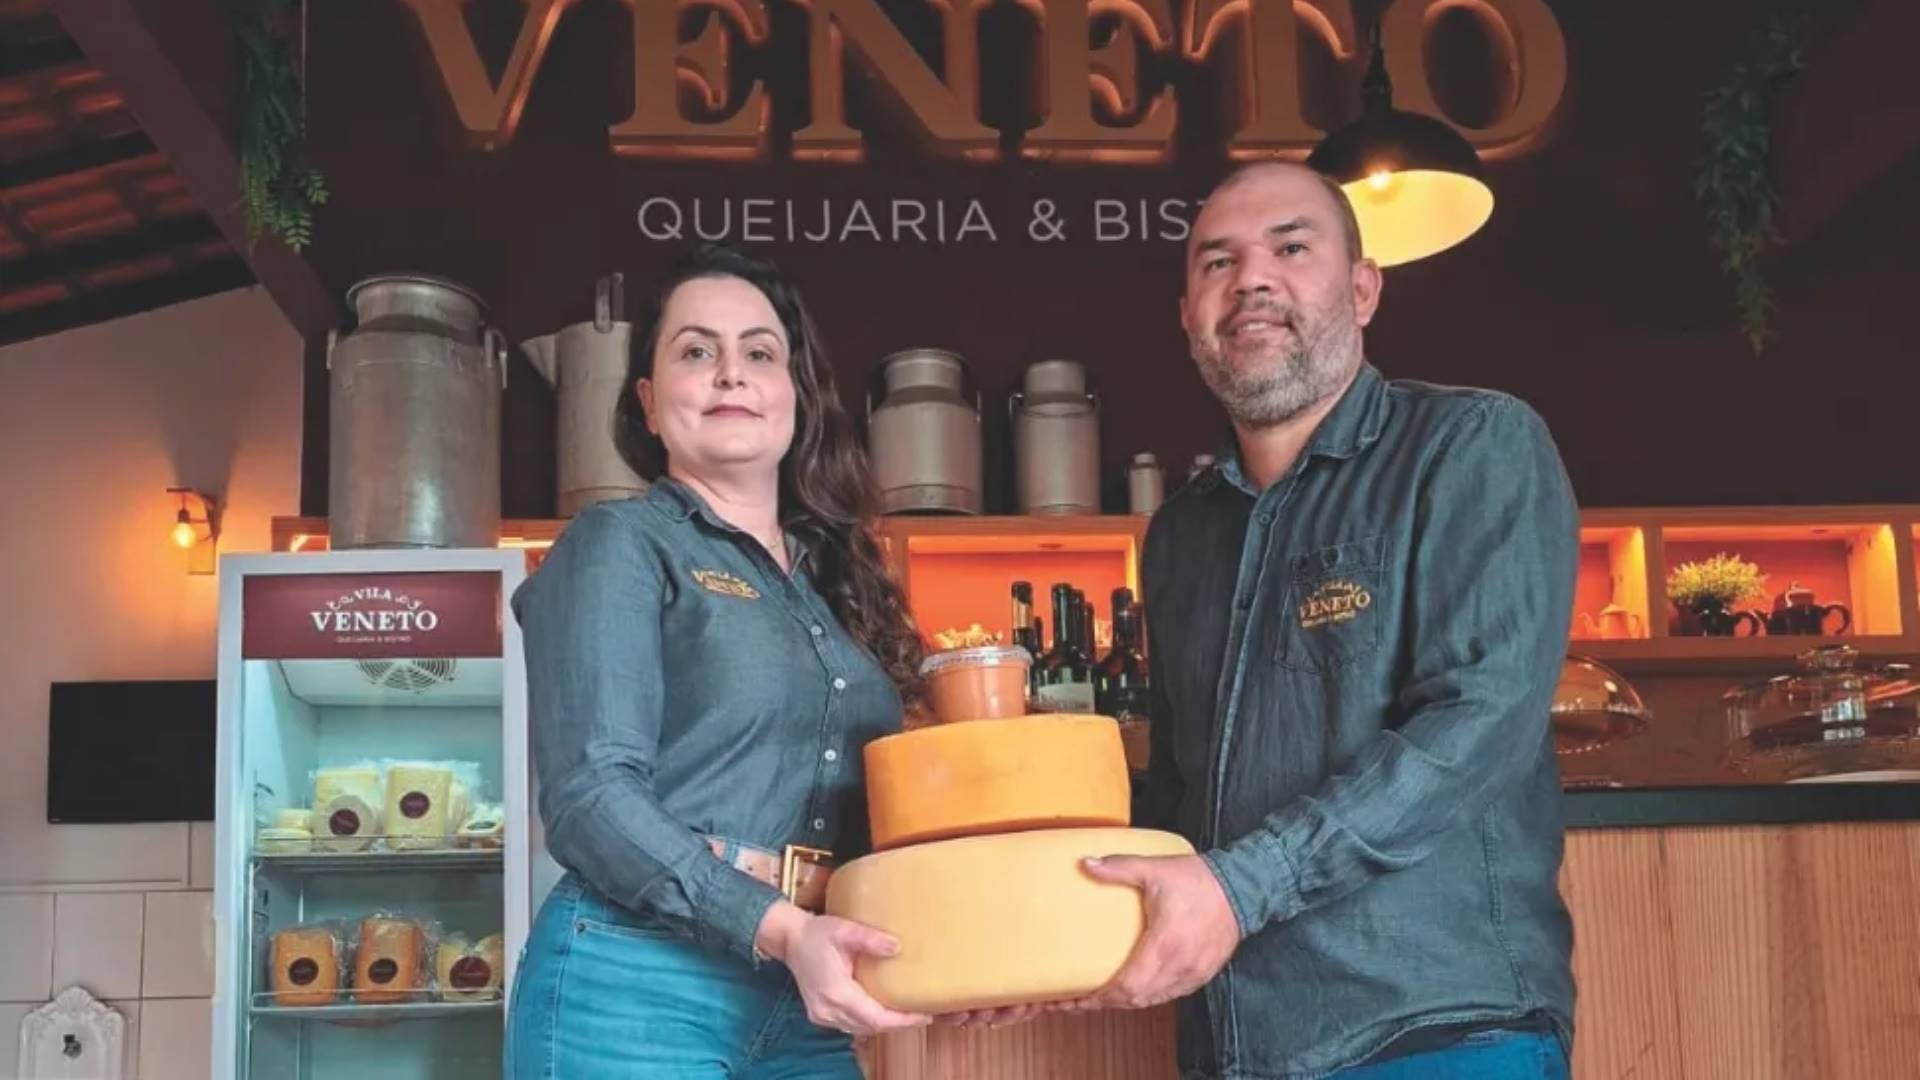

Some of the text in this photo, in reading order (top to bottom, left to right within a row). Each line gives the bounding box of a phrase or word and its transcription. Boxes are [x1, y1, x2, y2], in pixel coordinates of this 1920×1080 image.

[405, 0, 1568, 152] VENETO
[637, 197, 1205, 243] QUEIJARIA & BIS
[353, 586, 392, 600] VILA
[310, 610, 438, 632] VENETO
